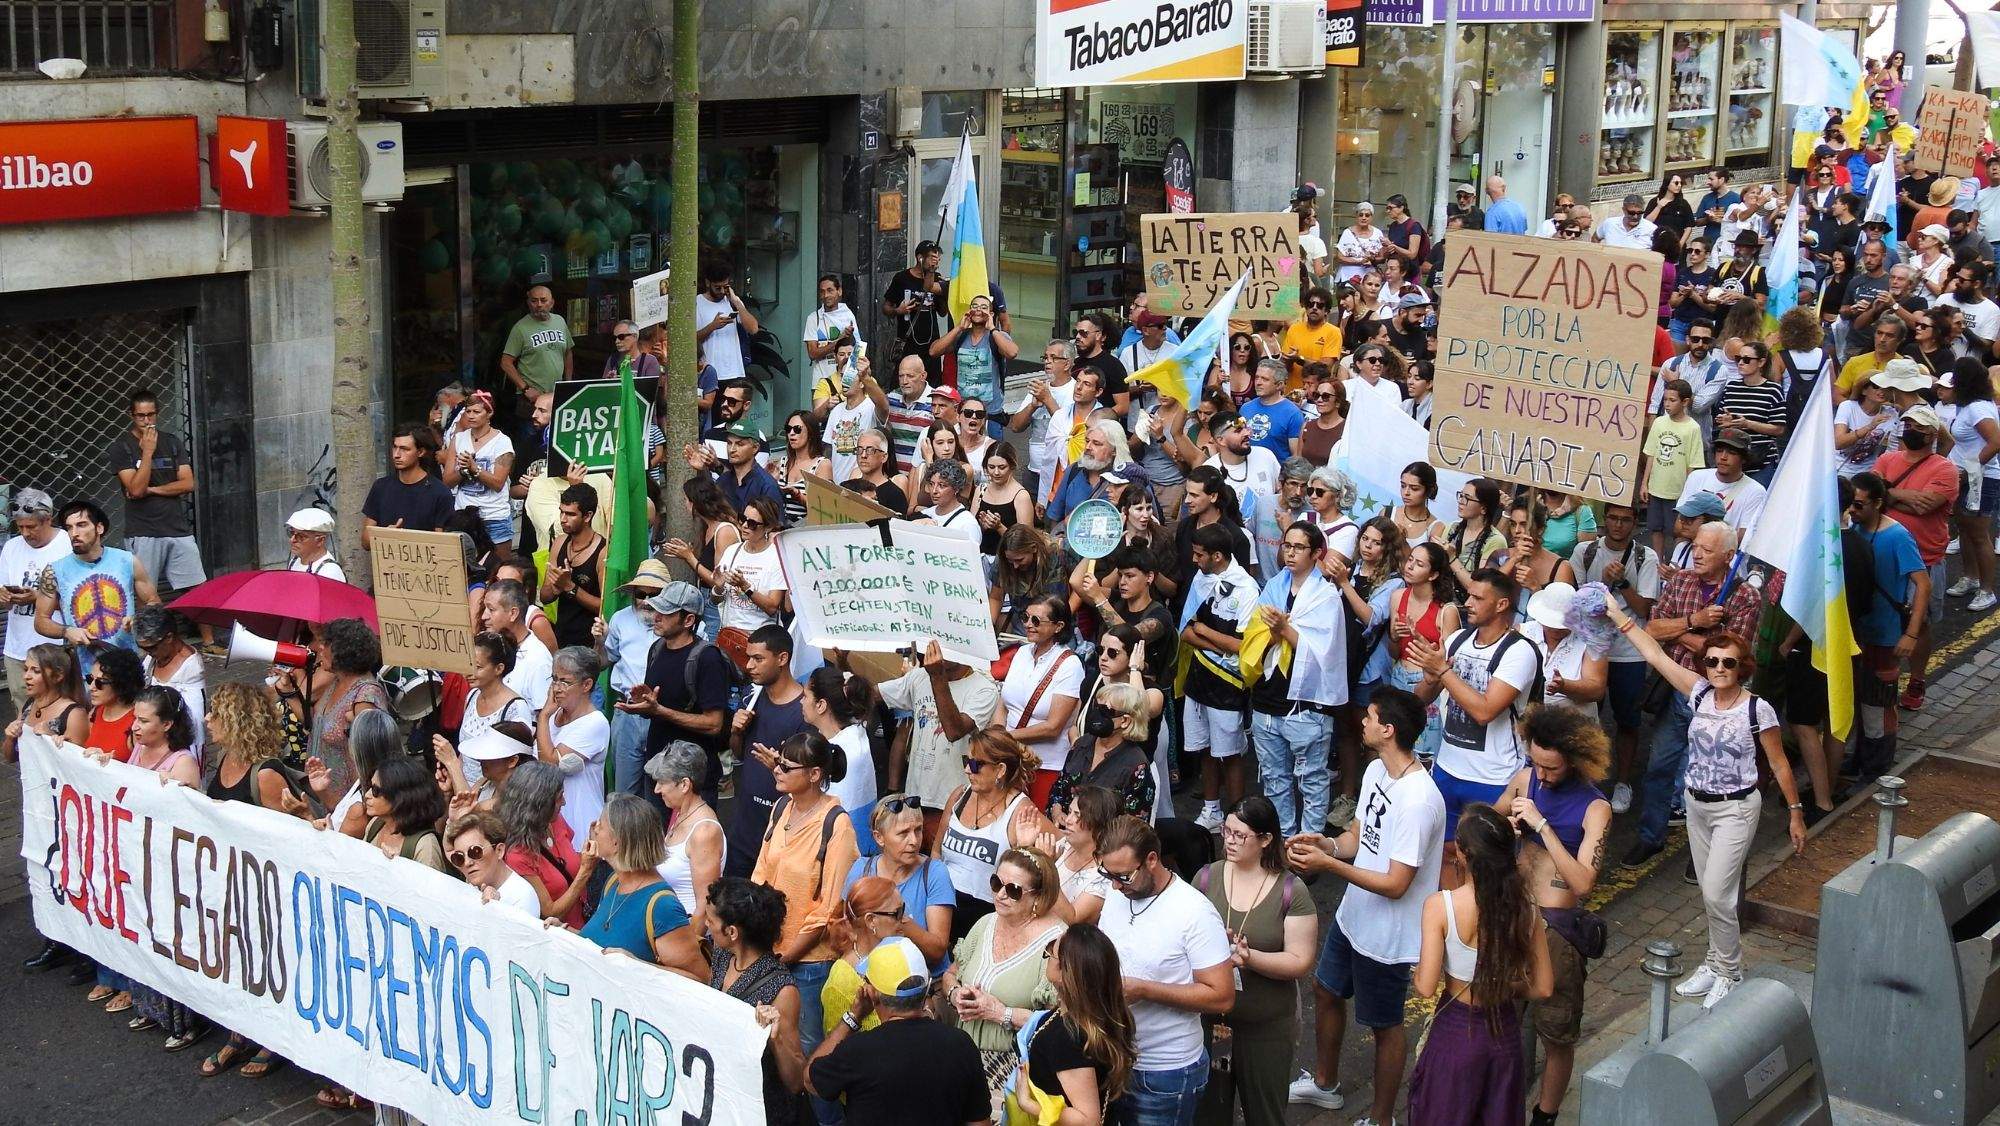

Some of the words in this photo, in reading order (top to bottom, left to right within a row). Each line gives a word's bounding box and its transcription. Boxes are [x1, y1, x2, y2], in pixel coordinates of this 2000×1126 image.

[867, 135, 876, 147] 21
[0, 155, 93, 190] ilbao
[1173, 258, 1202, 284] TE
[1213, 255, 1276, 282] AMA
[1447, 245, 1649, 319] ALZADAS
[530, 326, 566, 348] RIDE
[1502, 305, 1546, 340] POR
[1554, 312, 1583, 343] LA
[561, 405, 622, 433] BAST
[1463, 382, 1495, 410] DE
[1505, 386, 1639, 441] NUESTRAS
[1435, 415, 1629, 499] CANARIAS
[845, 544, 915, 568] TORRES
[923, 580, 939, 596] VP
[822, 600, 933, 620] LIECHTENSTEIN
[384, 622, 410, 649] PIDE
[753, 795, 775, 807] ESTABL
[143, 816, 288, 1004] LEGADO
[292, 870, 494, 1110] QUEREMOS
